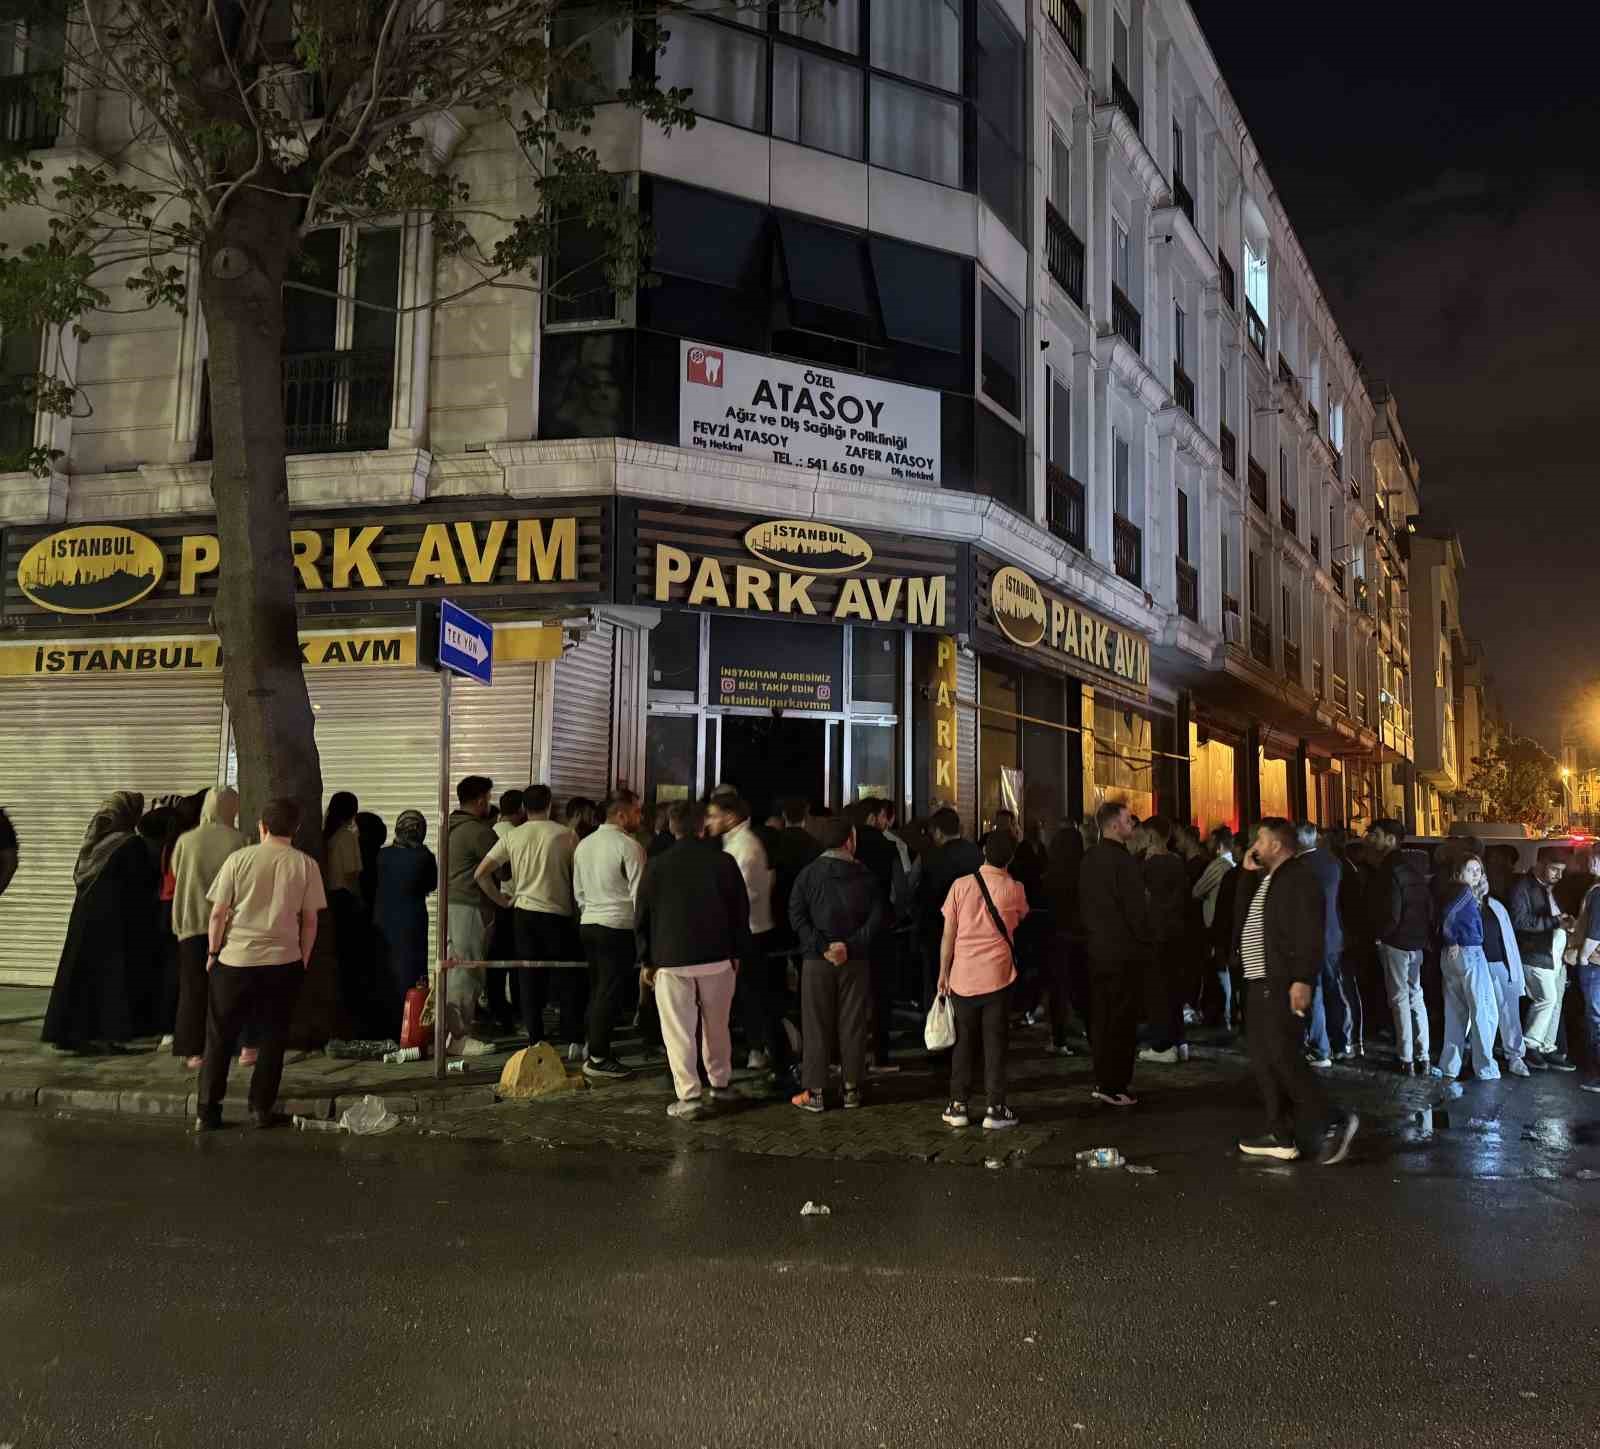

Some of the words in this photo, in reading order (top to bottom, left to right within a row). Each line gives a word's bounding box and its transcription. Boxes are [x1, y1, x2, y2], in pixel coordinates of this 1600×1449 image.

[804, 370, 836, 389] ÖZEL
[752, 379, 885, 428] ATASOY
[693, 420, 730, 438] FEVZİ
[733, 428, 789, 448] ATASOY
[726, 406, 756, 423] Ağız
[760, 416, 776, 426] ve
[781, 417, 799, 432] Diş
[803, 420, 846, 440] Sağlığı
[850, 429, 908, 450] Polikliniği
[807, 458, 828, 471] 541
[832, 461, 847, 474] 65
[850, 464, 865, 477] 09
[845, 445, 882, 462] ZAFER
[885, 452, 934, 470] ATASOY
[51, 536, 135, 558] İSTANBUL
[773, 524, 847, 544] İSTANBUL
[180, 526, 384, 595] PRK
[408, 517, 577, 585] AVM
[655, 543, 817, 616] PARK
[834, 575, 946, 627] AVM
[35, 646, 203, 673] İSTANBUL
[321, 640, 401, 664] AVM
[1051, 599, 1110, 669] PARK
[1114, 631, 1150, 686] AVM
[936, 640, 951, 787] PARK
